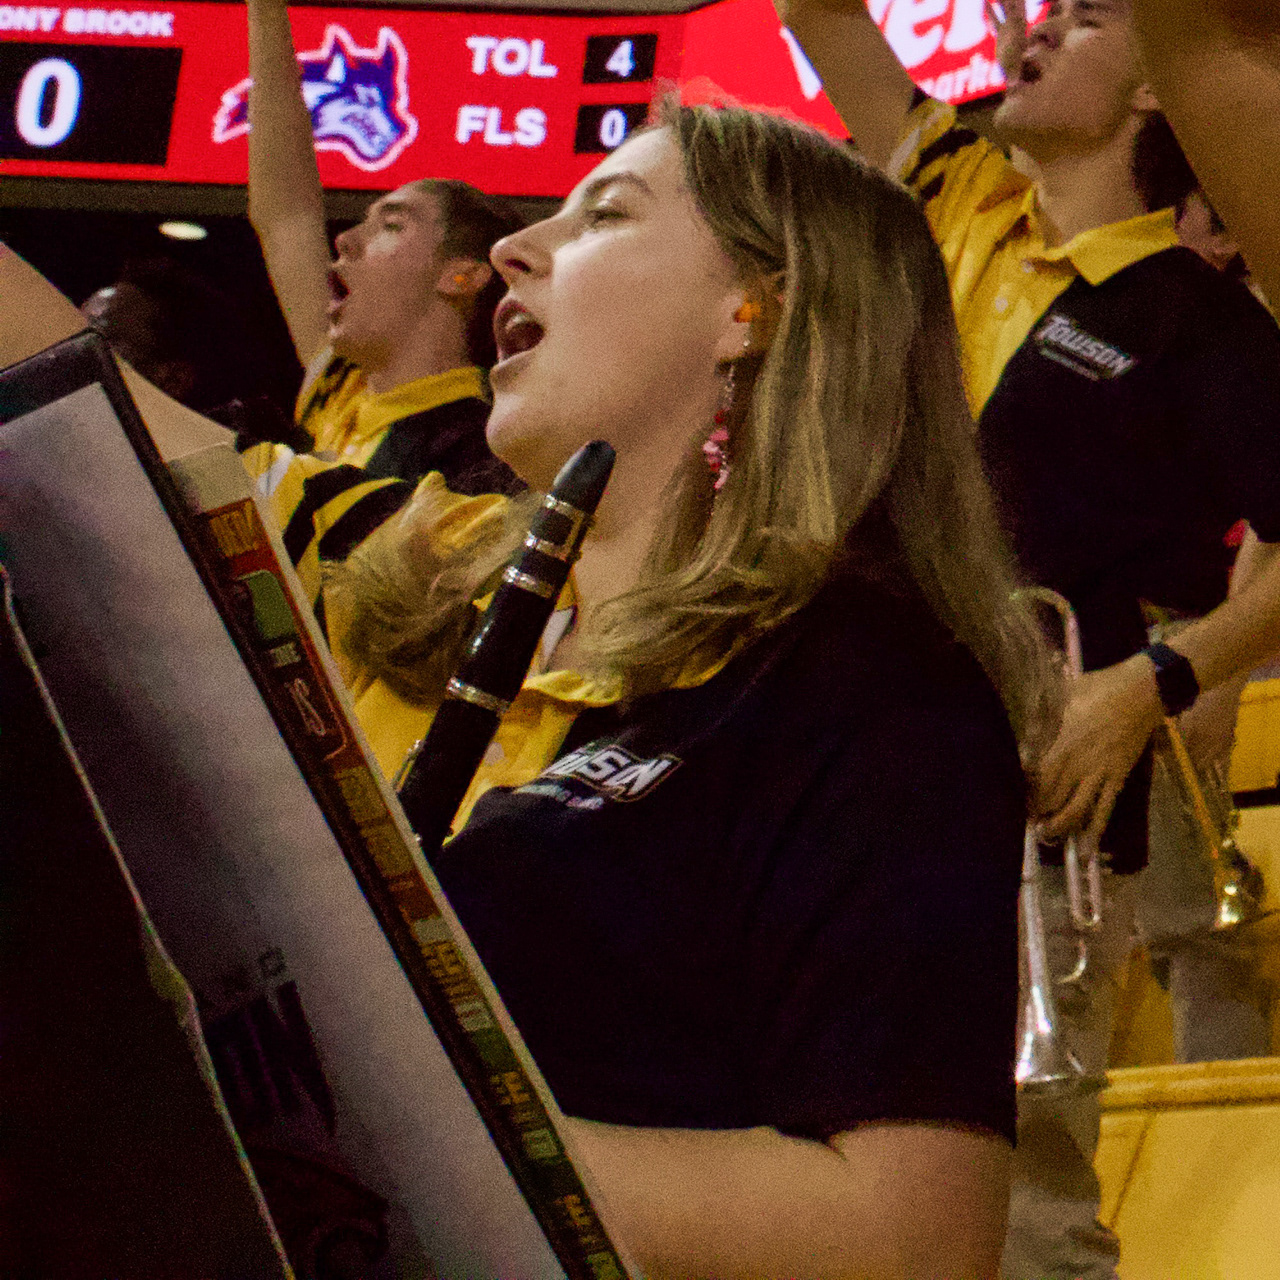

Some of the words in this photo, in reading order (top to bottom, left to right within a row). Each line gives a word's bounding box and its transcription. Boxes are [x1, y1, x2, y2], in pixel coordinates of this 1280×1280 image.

[63, 7, 176, 39] BROOK
[466, 35, 559, 78] TOL
[606, 39, 636, 77] 4
[16, 56, 84, 148] 0
[455, 105, 548, 148] FLS
[599, 108, 628, 148] 0
